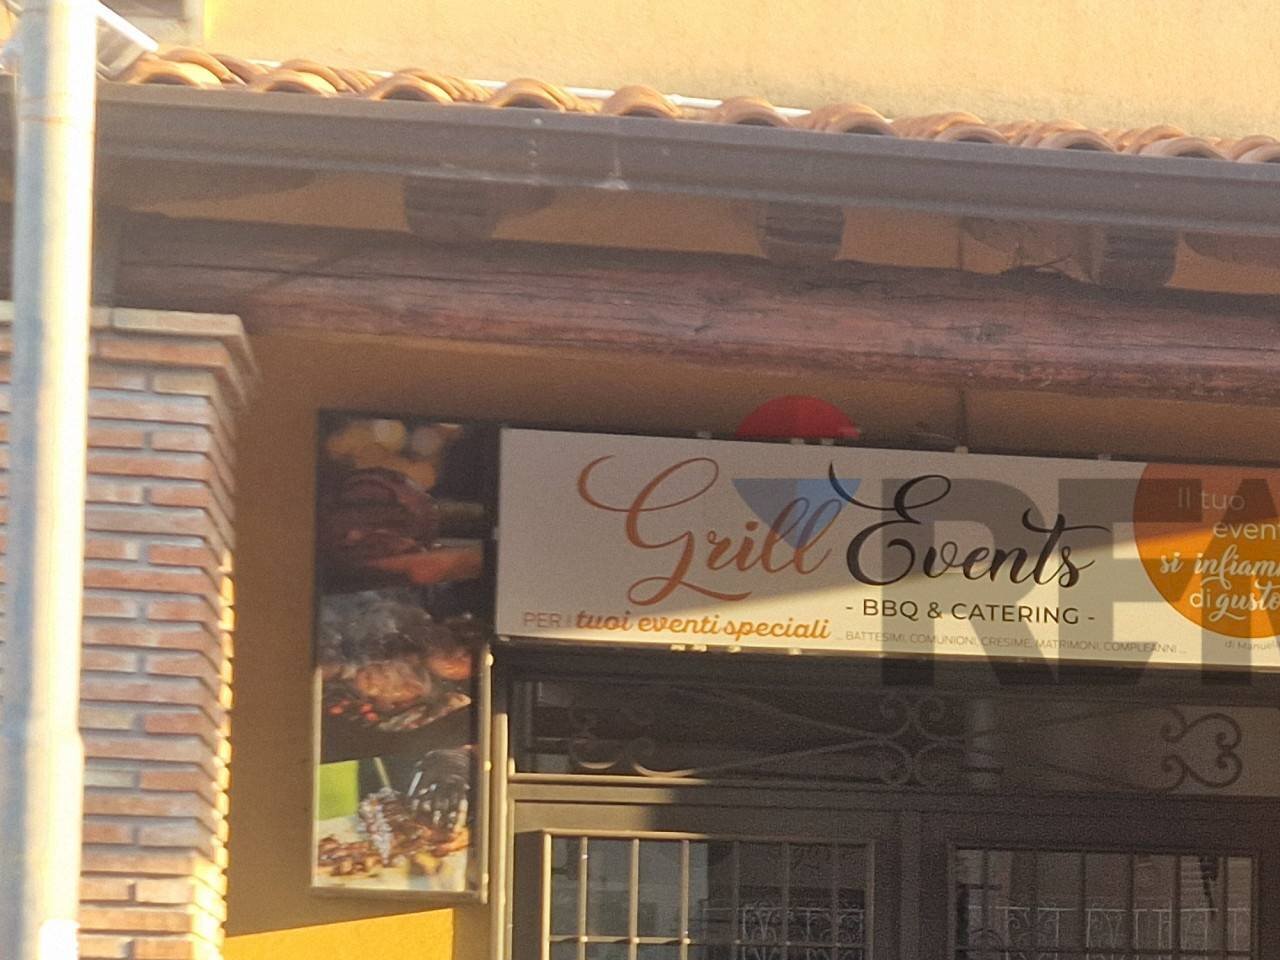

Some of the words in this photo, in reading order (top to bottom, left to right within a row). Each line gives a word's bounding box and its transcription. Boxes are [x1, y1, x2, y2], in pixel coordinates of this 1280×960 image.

[1201, 491, 1246, 511] tuo
[577, 455, 842, 606] Grill
[828, 461, 1112, 588] Events
[1160, 551, 1184, 574] si
[1190, 588, 1211, 609] di
[863, 599, 919, 621] BBQ
[927, 601, 944, 620] &
[951, 603, 1080, 625] CATERING
[523, 612, 562, 628] PER
[574, 610, 633, 630] tuoi
[637, 614, 720, 634] eventi
[722, 618, 830, 641] speciali
